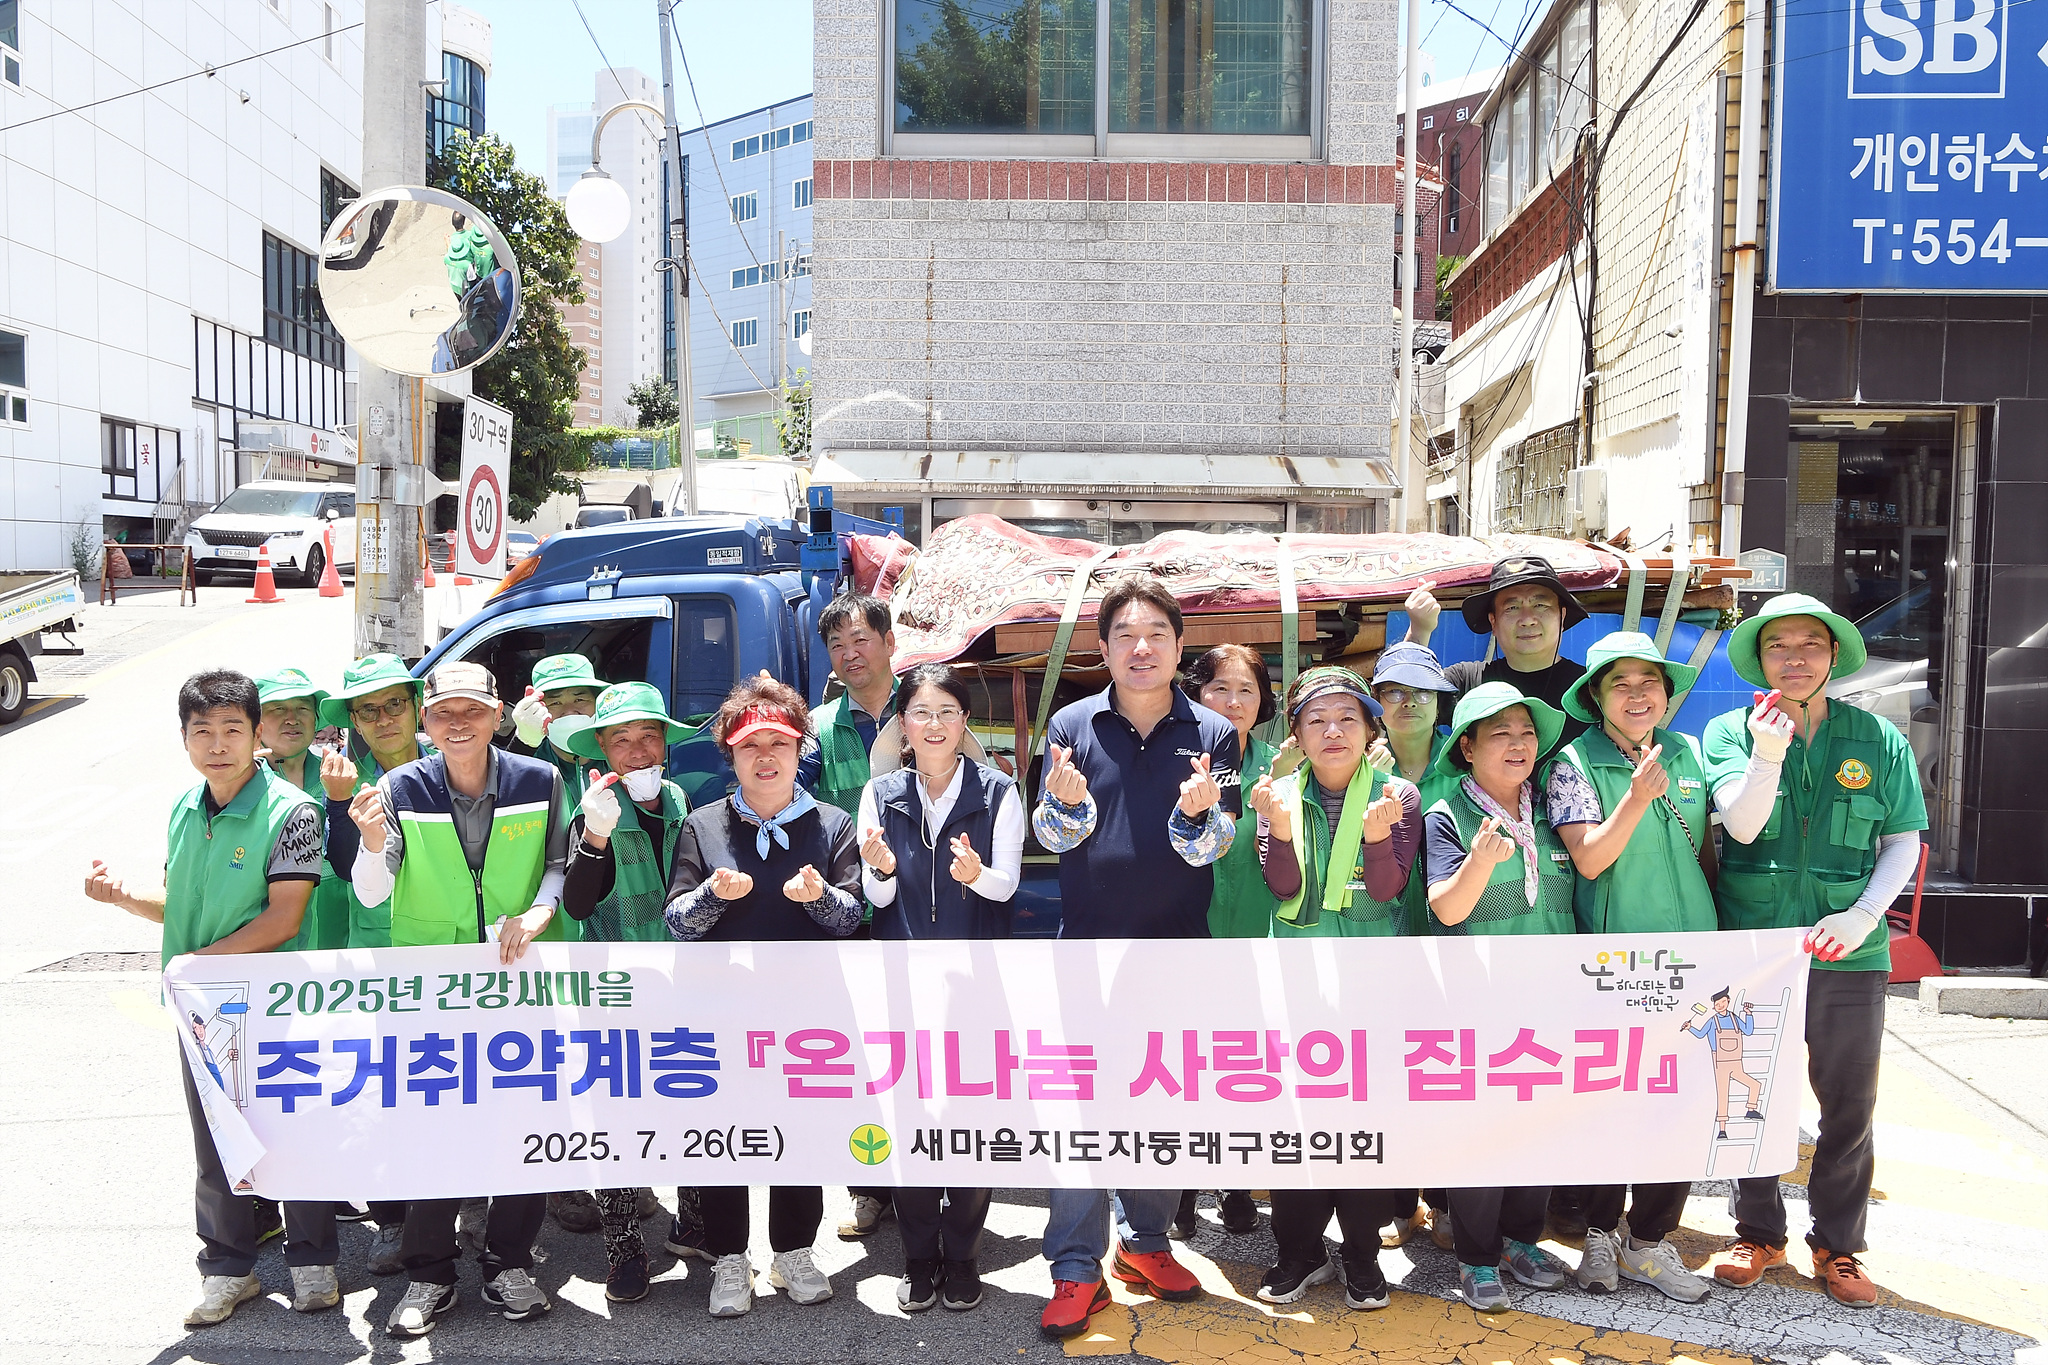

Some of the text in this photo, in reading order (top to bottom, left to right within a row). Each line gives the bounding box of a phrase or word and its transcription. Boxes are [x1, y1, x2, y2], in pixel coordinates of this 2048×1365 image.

[1860, 0, 1998, 76] SB
[319, 438, 330, 453] OUT
[469, 411, 508, 453] 30 구역
[475, 494, 493, 534] 30
[285, 814, 315, 839] MON
[1580, 949, 1697, 992] 온기나눔
[1616, 979, 1667, 995] 하나되는
[265, 970, 634, 1018] 2025년 건강새마을
[1626, 994, 1680, 1012] 대한민국
[254, 1027, 722, 1114] 주거취약계층
[1129, 1028, 1368, 1102] 사랑의
[522, 1124, 786, 1165] 2025. 7. 26(토)
[910, 1127, 1385, 1167] 새마을지도자동래구협의회
